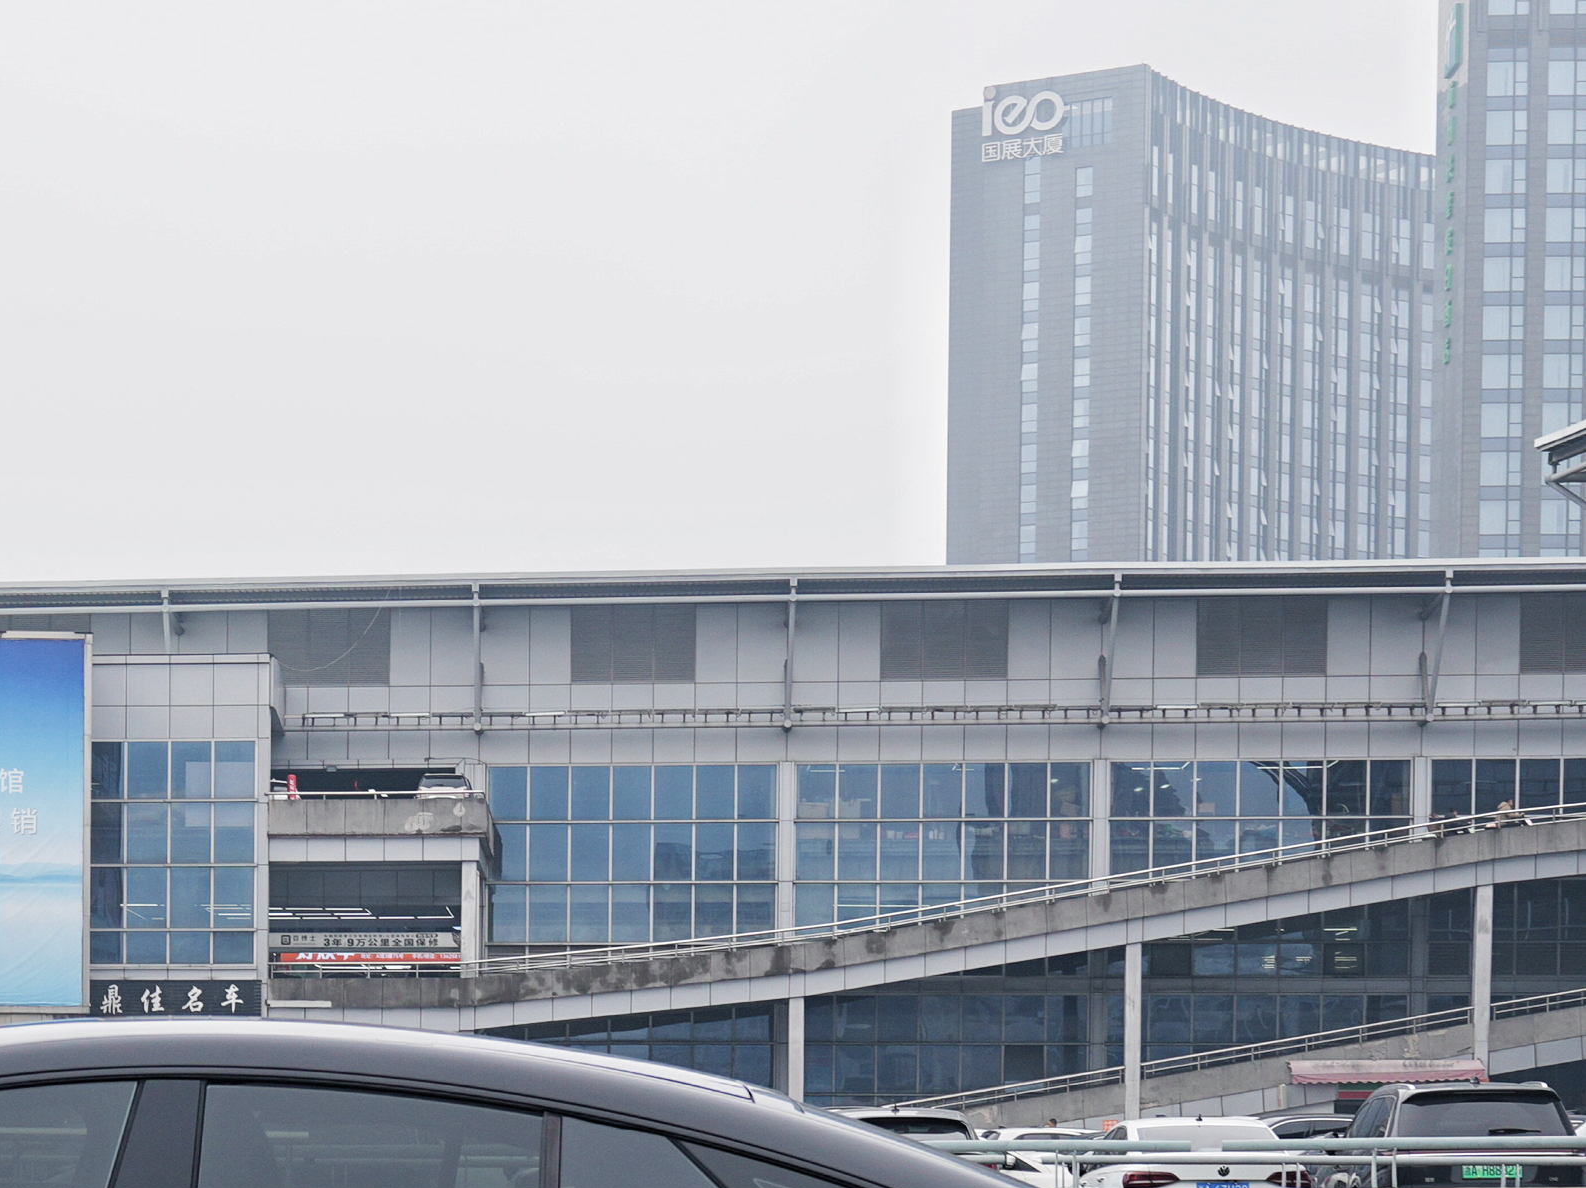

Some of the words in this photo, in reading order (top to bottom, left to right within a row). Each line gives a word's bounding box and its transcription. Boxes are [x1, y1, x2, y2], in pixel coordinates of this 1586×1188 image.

[981, 133, 1065, 163] 国展大厦
[99, 983, 245, 1015] 鼎佳名车
